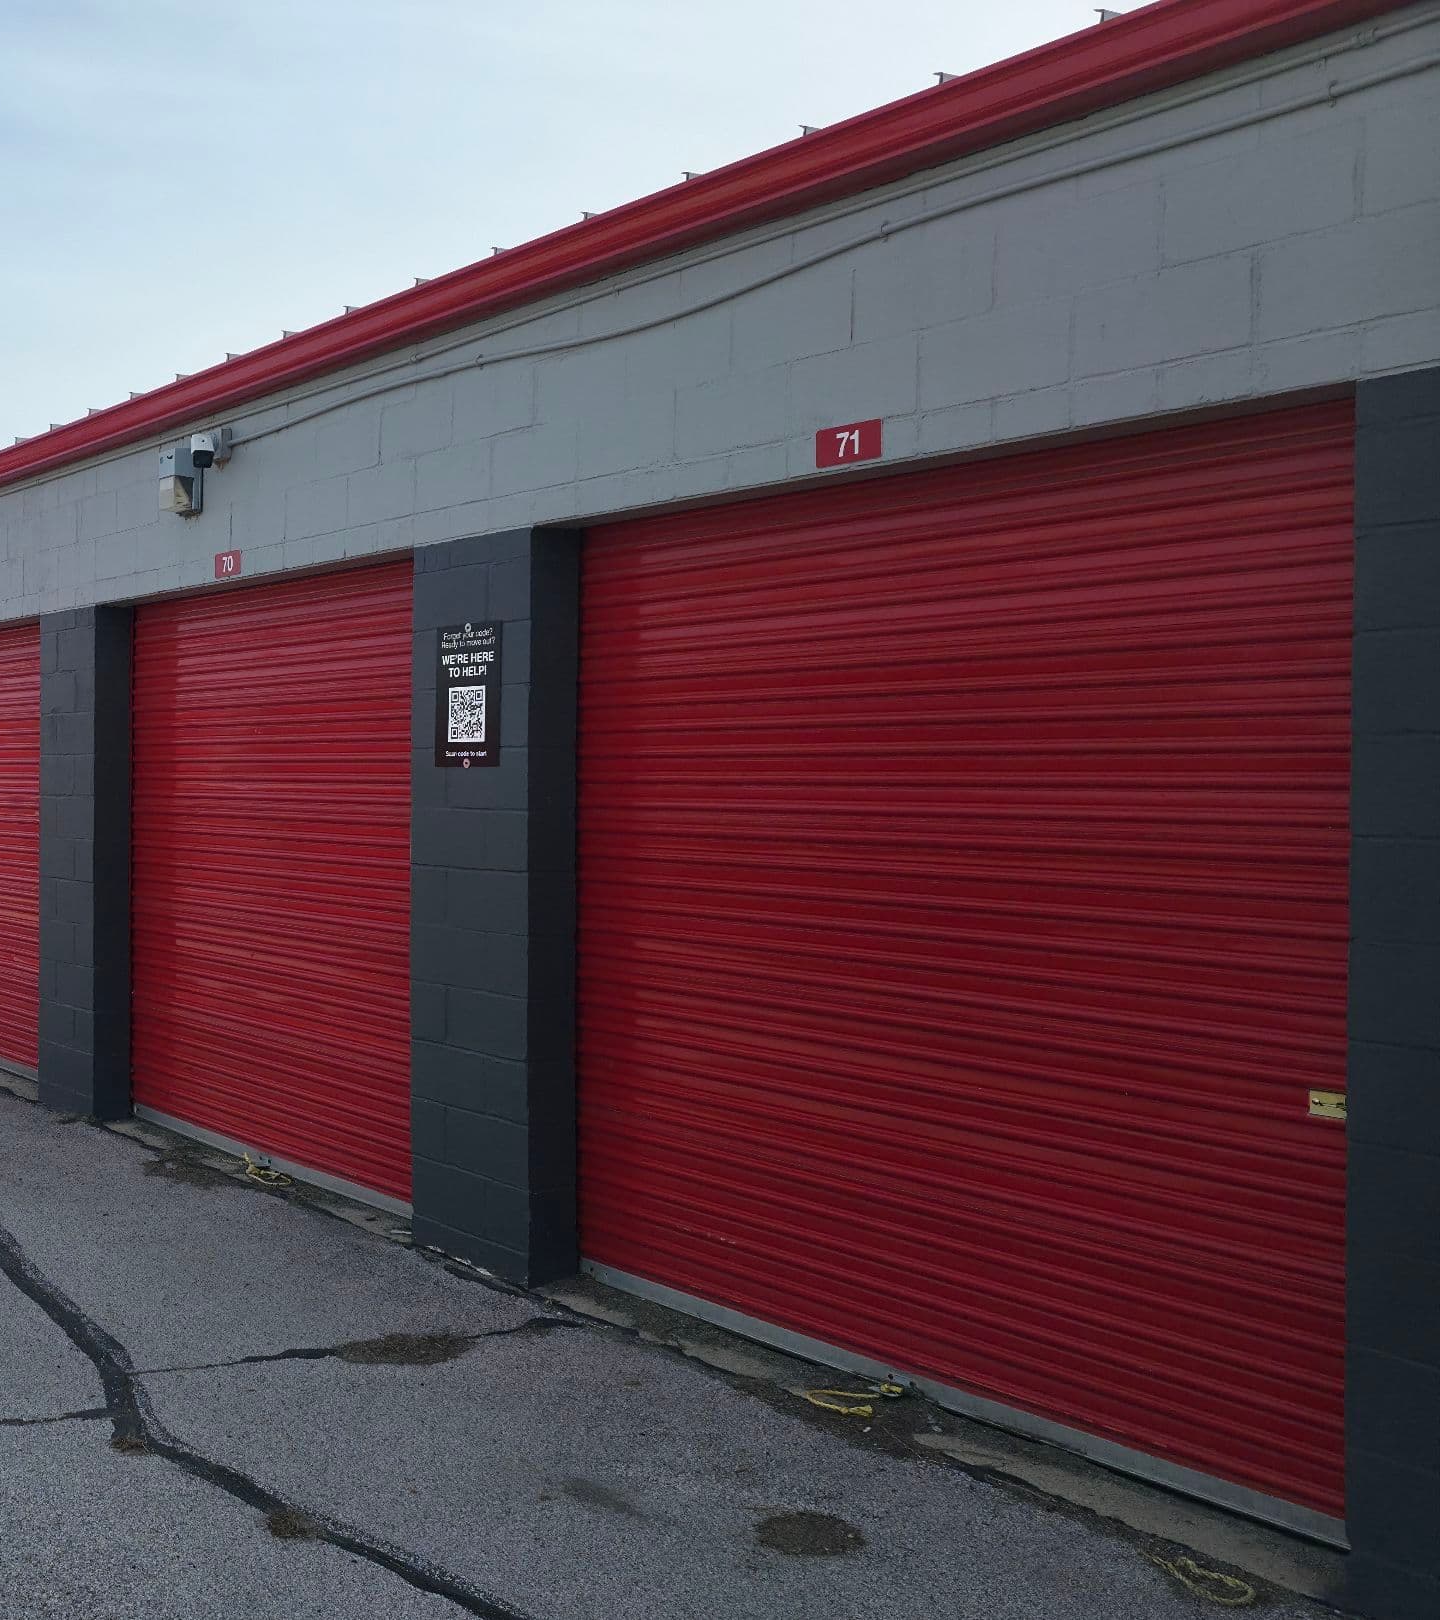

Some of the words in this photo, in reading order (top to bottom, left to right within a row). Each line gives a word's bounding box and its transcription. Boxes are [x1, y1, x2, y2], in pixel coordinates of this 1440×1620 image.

[836, 429, 859, 457] 71
[222, 555, 233, 572] 70
[441, 640, 458, 649] Ready
[482, 636, 495, 645] out?
[442, 653, 468, 665] WE'RE
[470, 651, 494, 663] HERE
[448, 667, 460, 677] TO
[462, 665, 487, 676] HELP!
